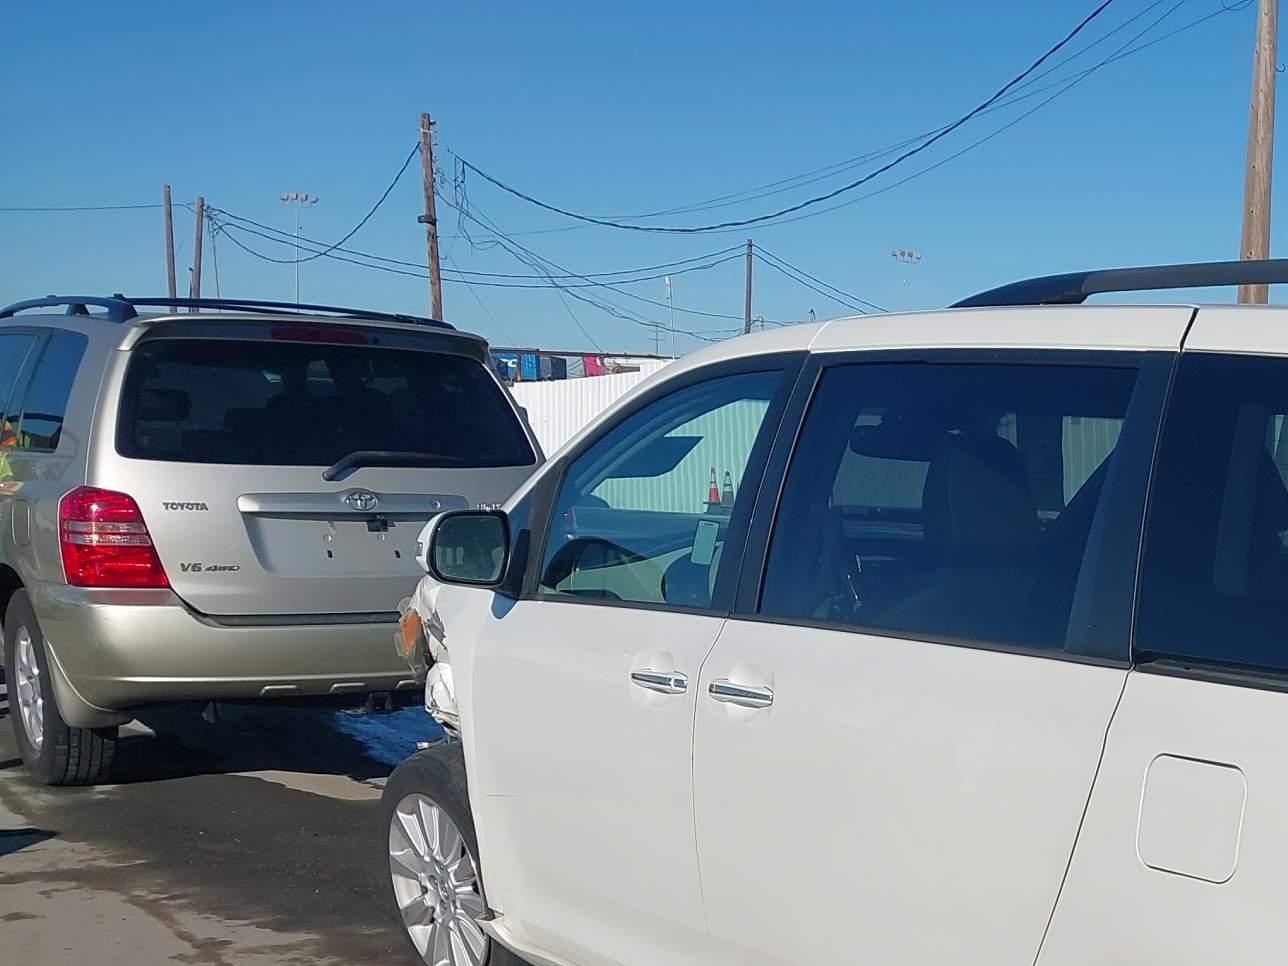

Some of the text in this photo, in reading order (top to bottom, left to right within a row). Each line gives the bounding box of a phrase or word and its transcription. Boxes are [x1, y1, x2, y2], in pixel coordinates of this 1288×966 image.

[162, 502, 209, 511] TOYOTA
[179, 563, 240, 572] V6 4WD
